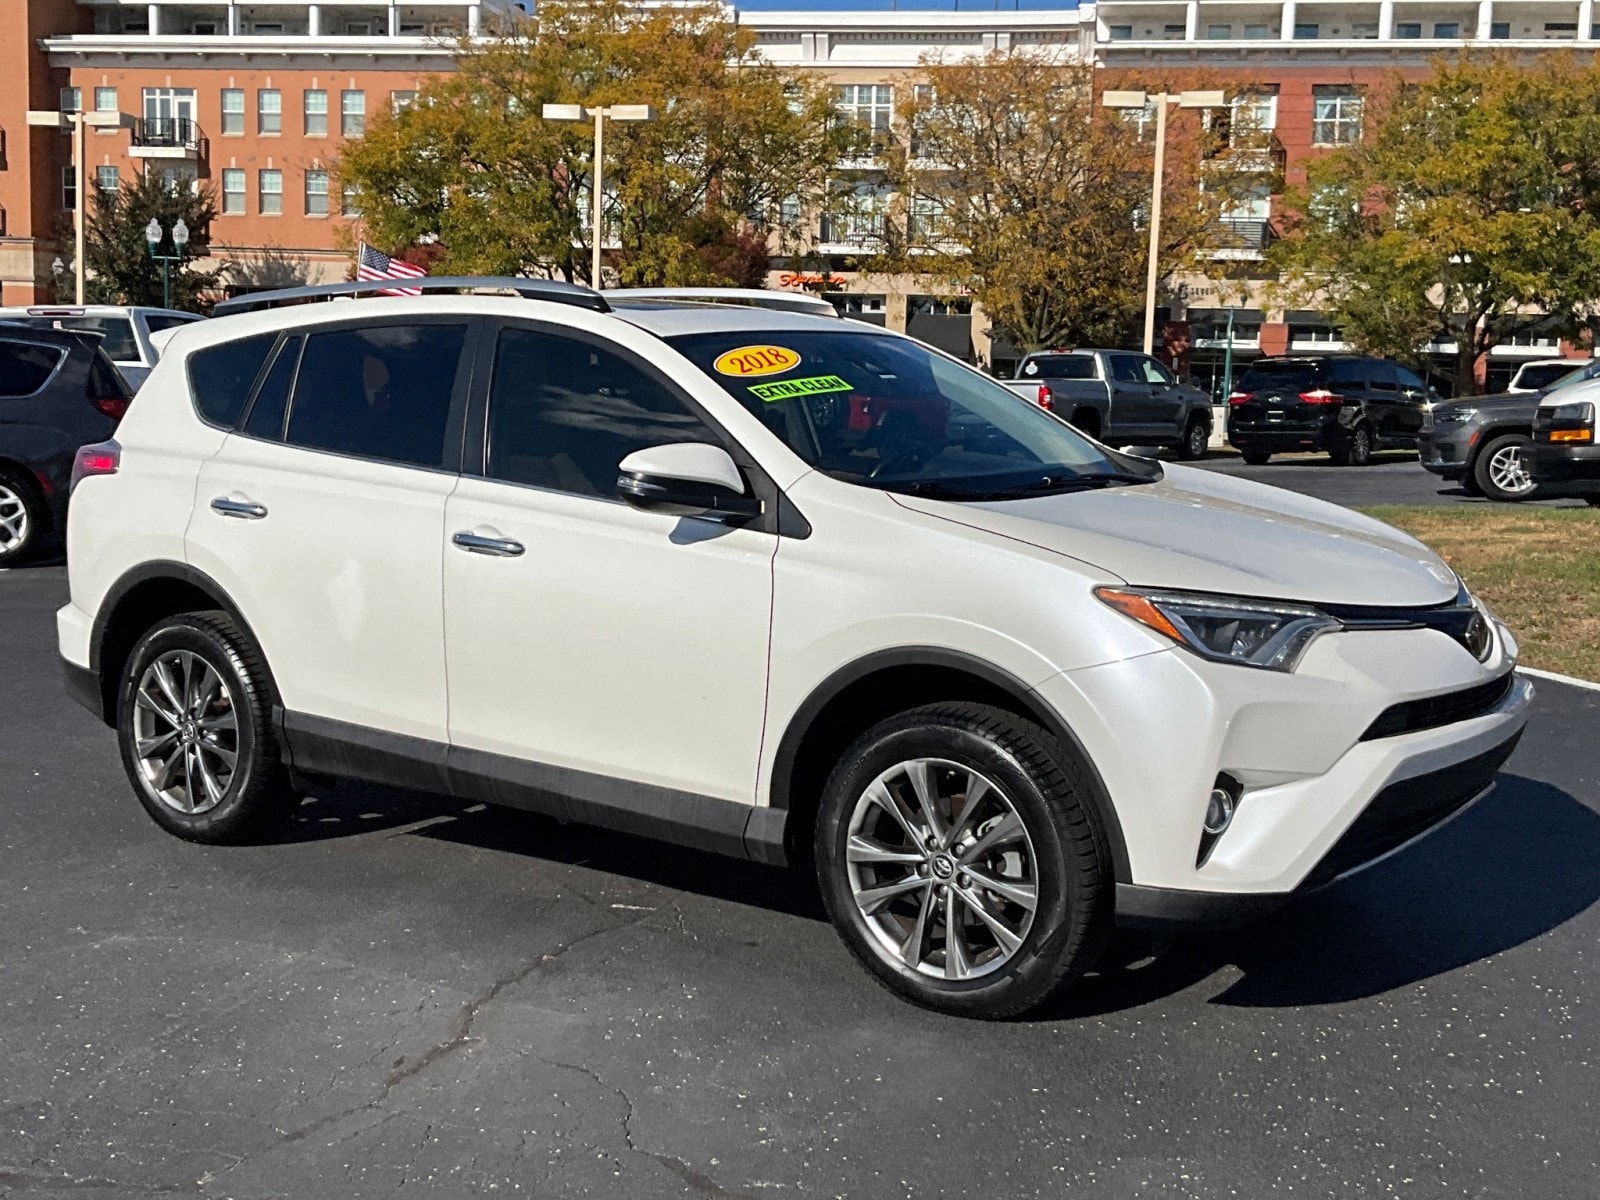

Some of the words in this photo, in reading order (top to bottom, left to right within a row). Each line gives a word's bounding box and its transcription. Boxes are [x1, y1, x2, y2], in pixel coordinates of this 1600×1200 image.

[729, 347, 789, 374] 2018
[754, 384, 802, 399] EXTRA
[802, 378, 846, 392] CLEAN
